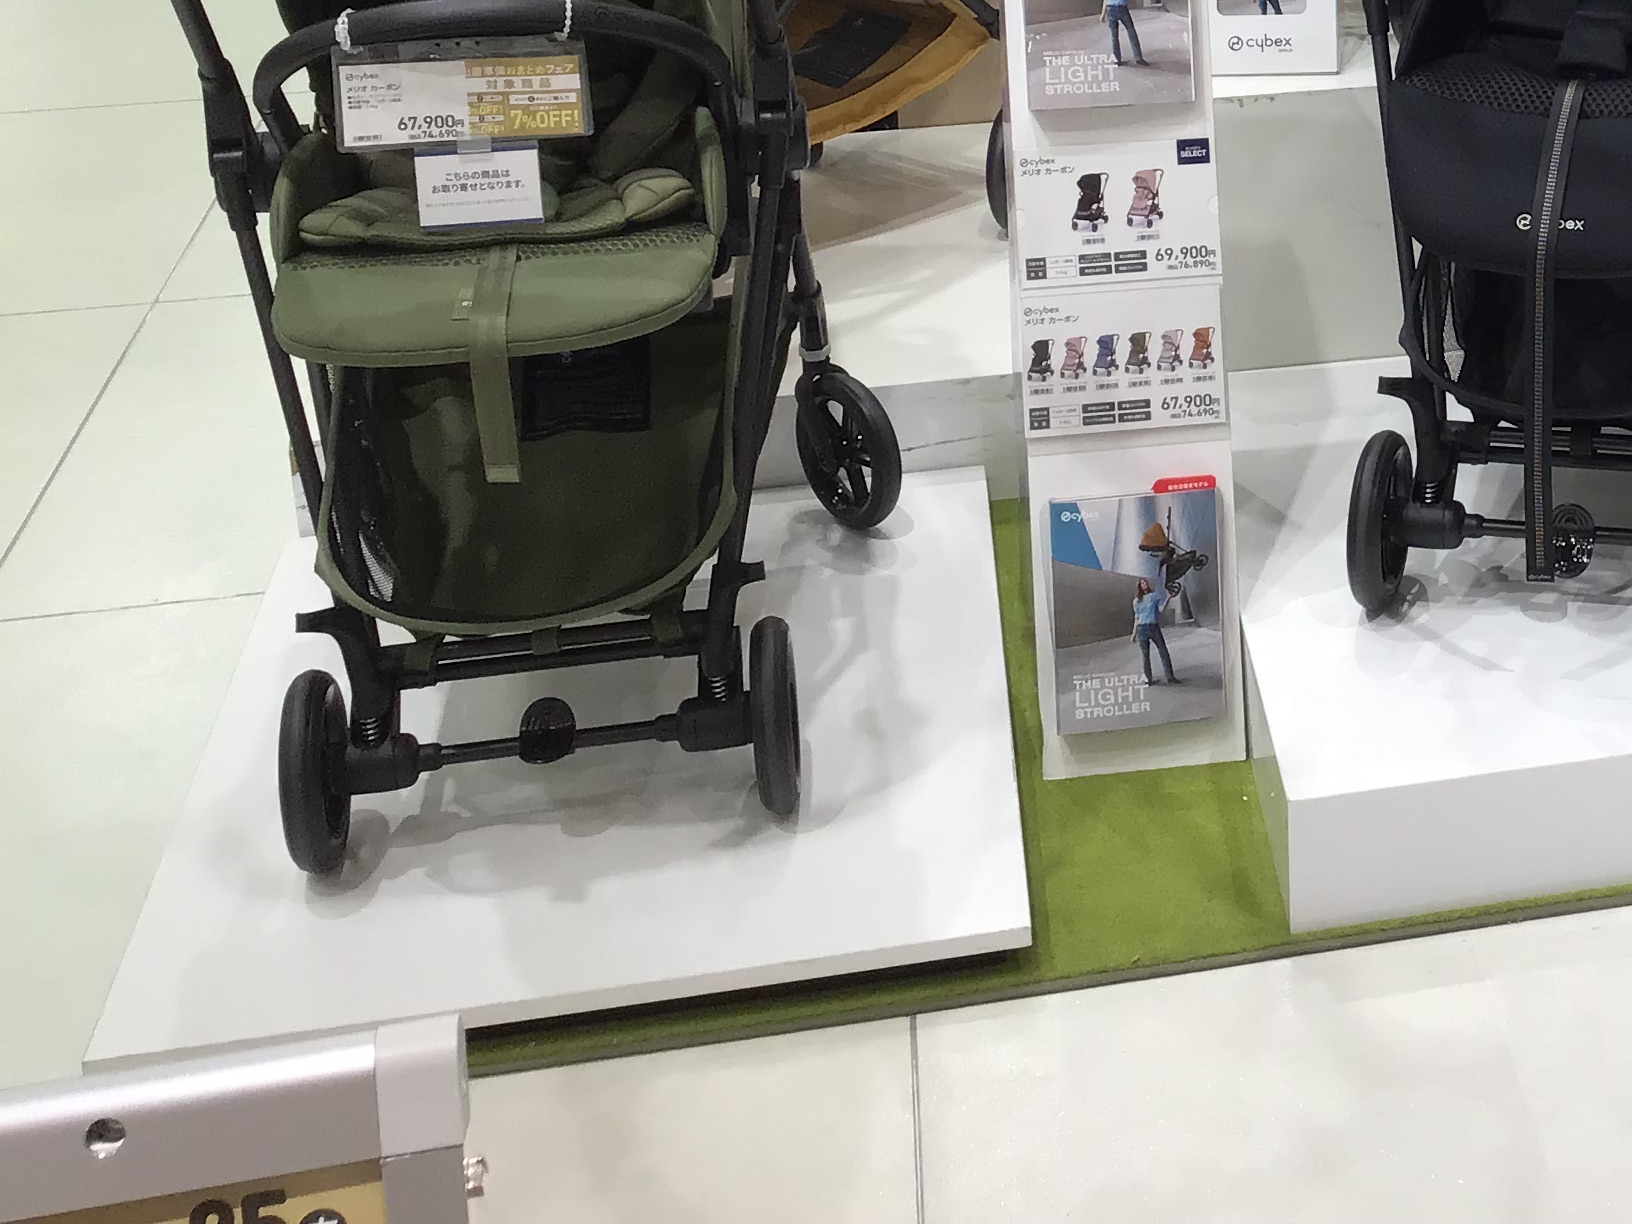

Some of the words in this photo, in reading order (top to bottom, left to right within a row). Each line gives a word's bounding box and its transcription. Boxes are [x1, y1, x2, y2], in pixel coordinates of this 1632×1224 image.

[1245, 33, 1293, 54] cybex
[1043, 55, 1070, 66] THE
[1074, 54, 1118, 66] ULTRA
[1045, 65, 1119, 84] LIGHT
[1045, 82, 1120, 96] STROLLER
[397, 114, 465, 131] 67,900円
[510, 108, 579, 129] 7%OFF!
[445, 168, 510, 182] こちらの商品は
[1020, 167, 1042, 176] メリオ
[1044, 165, 1075, 175] カーボン
[1155, 245, 1216, 262] 69,900円
[1024, 317, 1046, 326] メリオ
[1048, 315, 1079, 324] カーボン
[1161, 393, 1220, 411] 67,900円
[1073, 679, 1100, 690] THE
[1104, 674, 1149, 688] ULTRA
[1075, 684, 1150, 708] LIGHT
[1075, 702, 1151, 720] STROLLER
